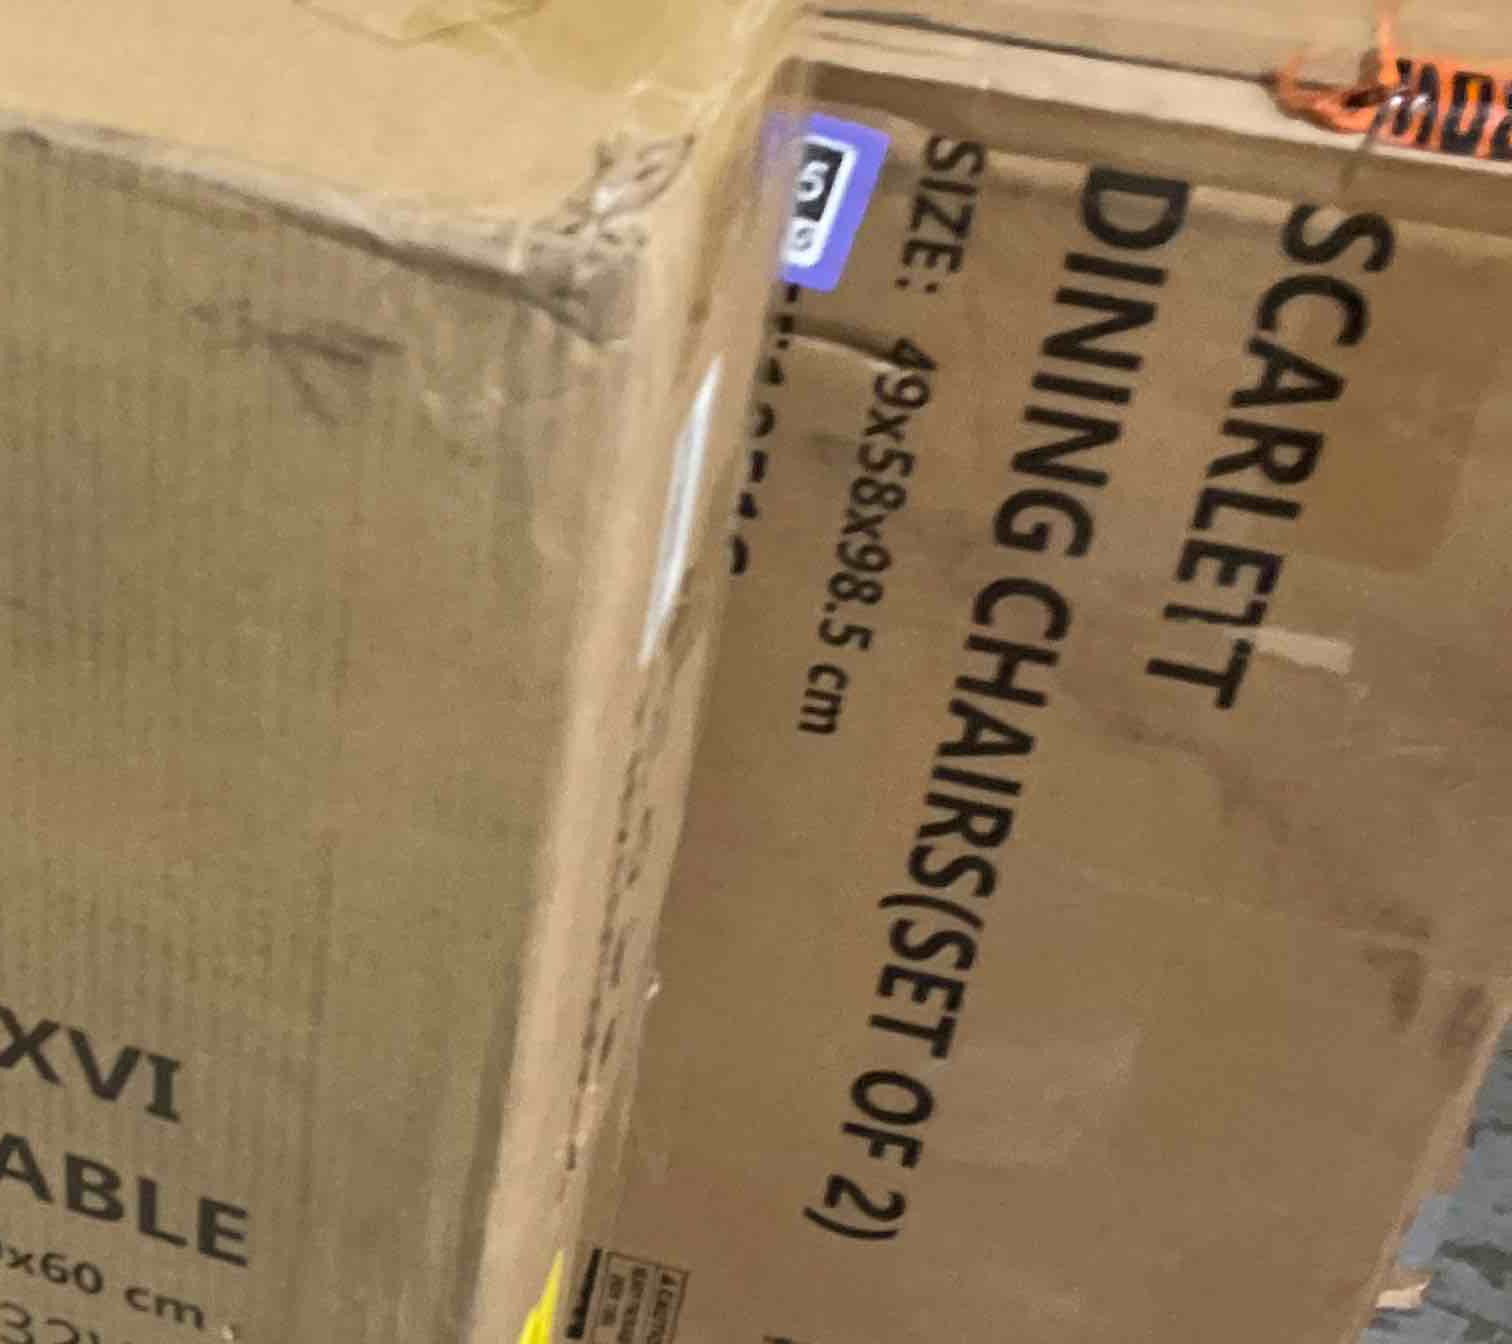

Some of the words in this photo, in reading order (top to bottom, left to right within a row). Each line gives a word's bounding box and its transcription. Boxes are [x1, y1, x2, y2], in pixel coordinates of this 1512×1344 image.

[893, 134, 985, 295] SIZE:
[991, 165, 1191, 559] DINING
[818, 335, 938, 652] 49x58x98.5
[1145, 202, 1396, 711] SCARLETT
[797, 662, 851, 736] cm
[841, 1068, 935, 1170] OF
[802, 1173, 907, 1242] 2)
[124, 1284, 207, 1330] cm
